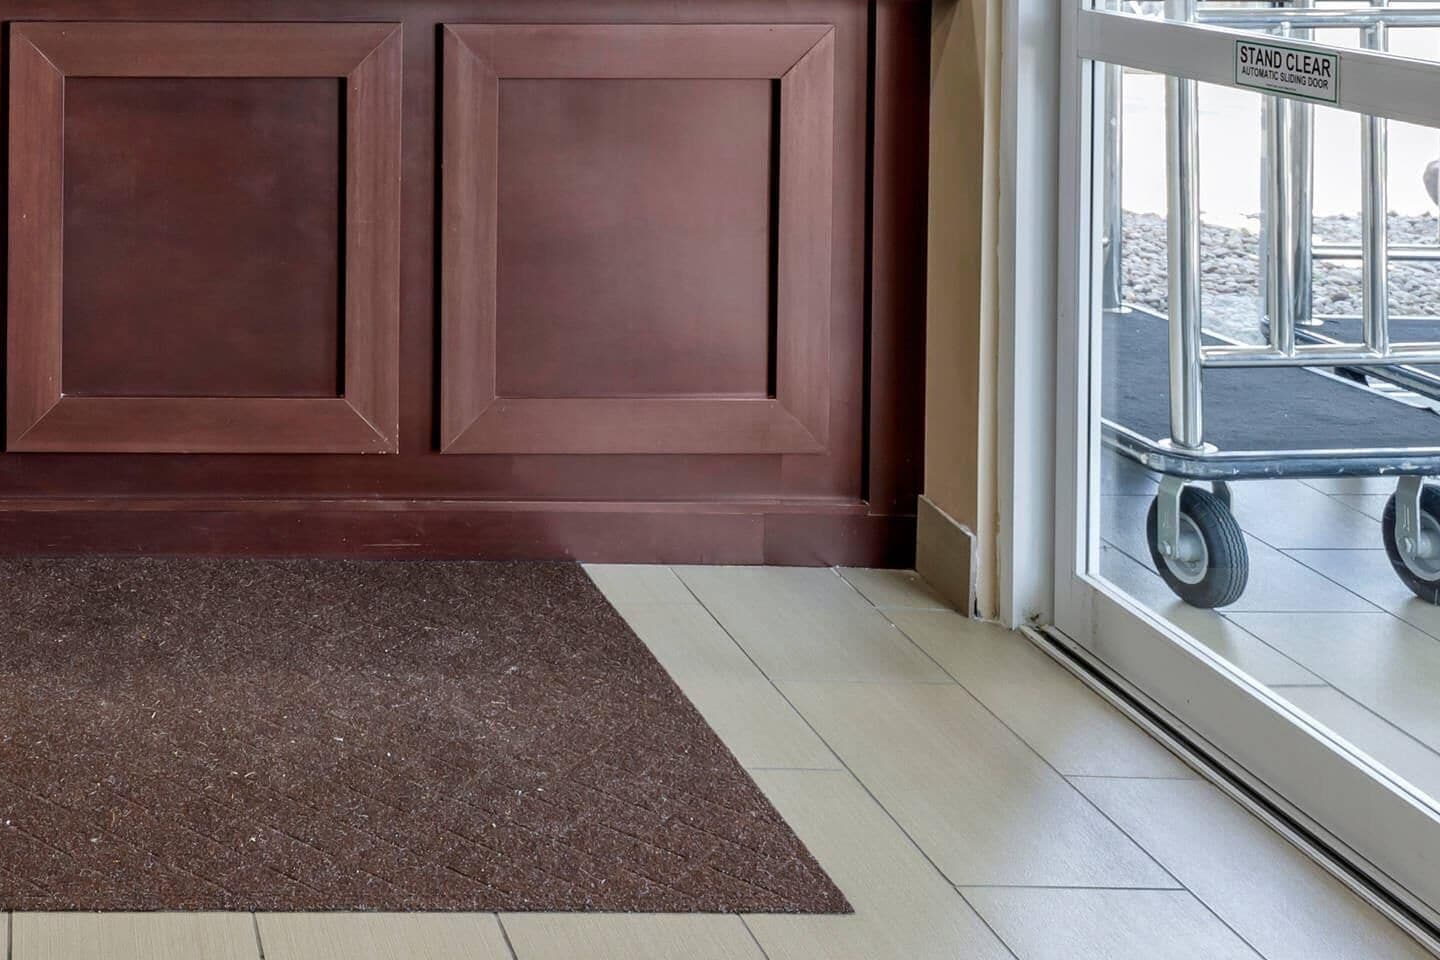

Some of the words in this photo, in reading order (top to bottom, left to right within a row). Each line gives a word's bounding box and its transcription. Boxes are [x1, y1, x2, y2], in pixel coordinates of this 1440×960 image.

[1240, 45, 1282, 69] STAND
[1286, 53, 1331, 78] CLEAR
[1241, 65, 1279, 81] AUTOMATIC
[1280, 72, 1306, 86] SLIDING
[1307, 76, 1329, 90] DOOR
